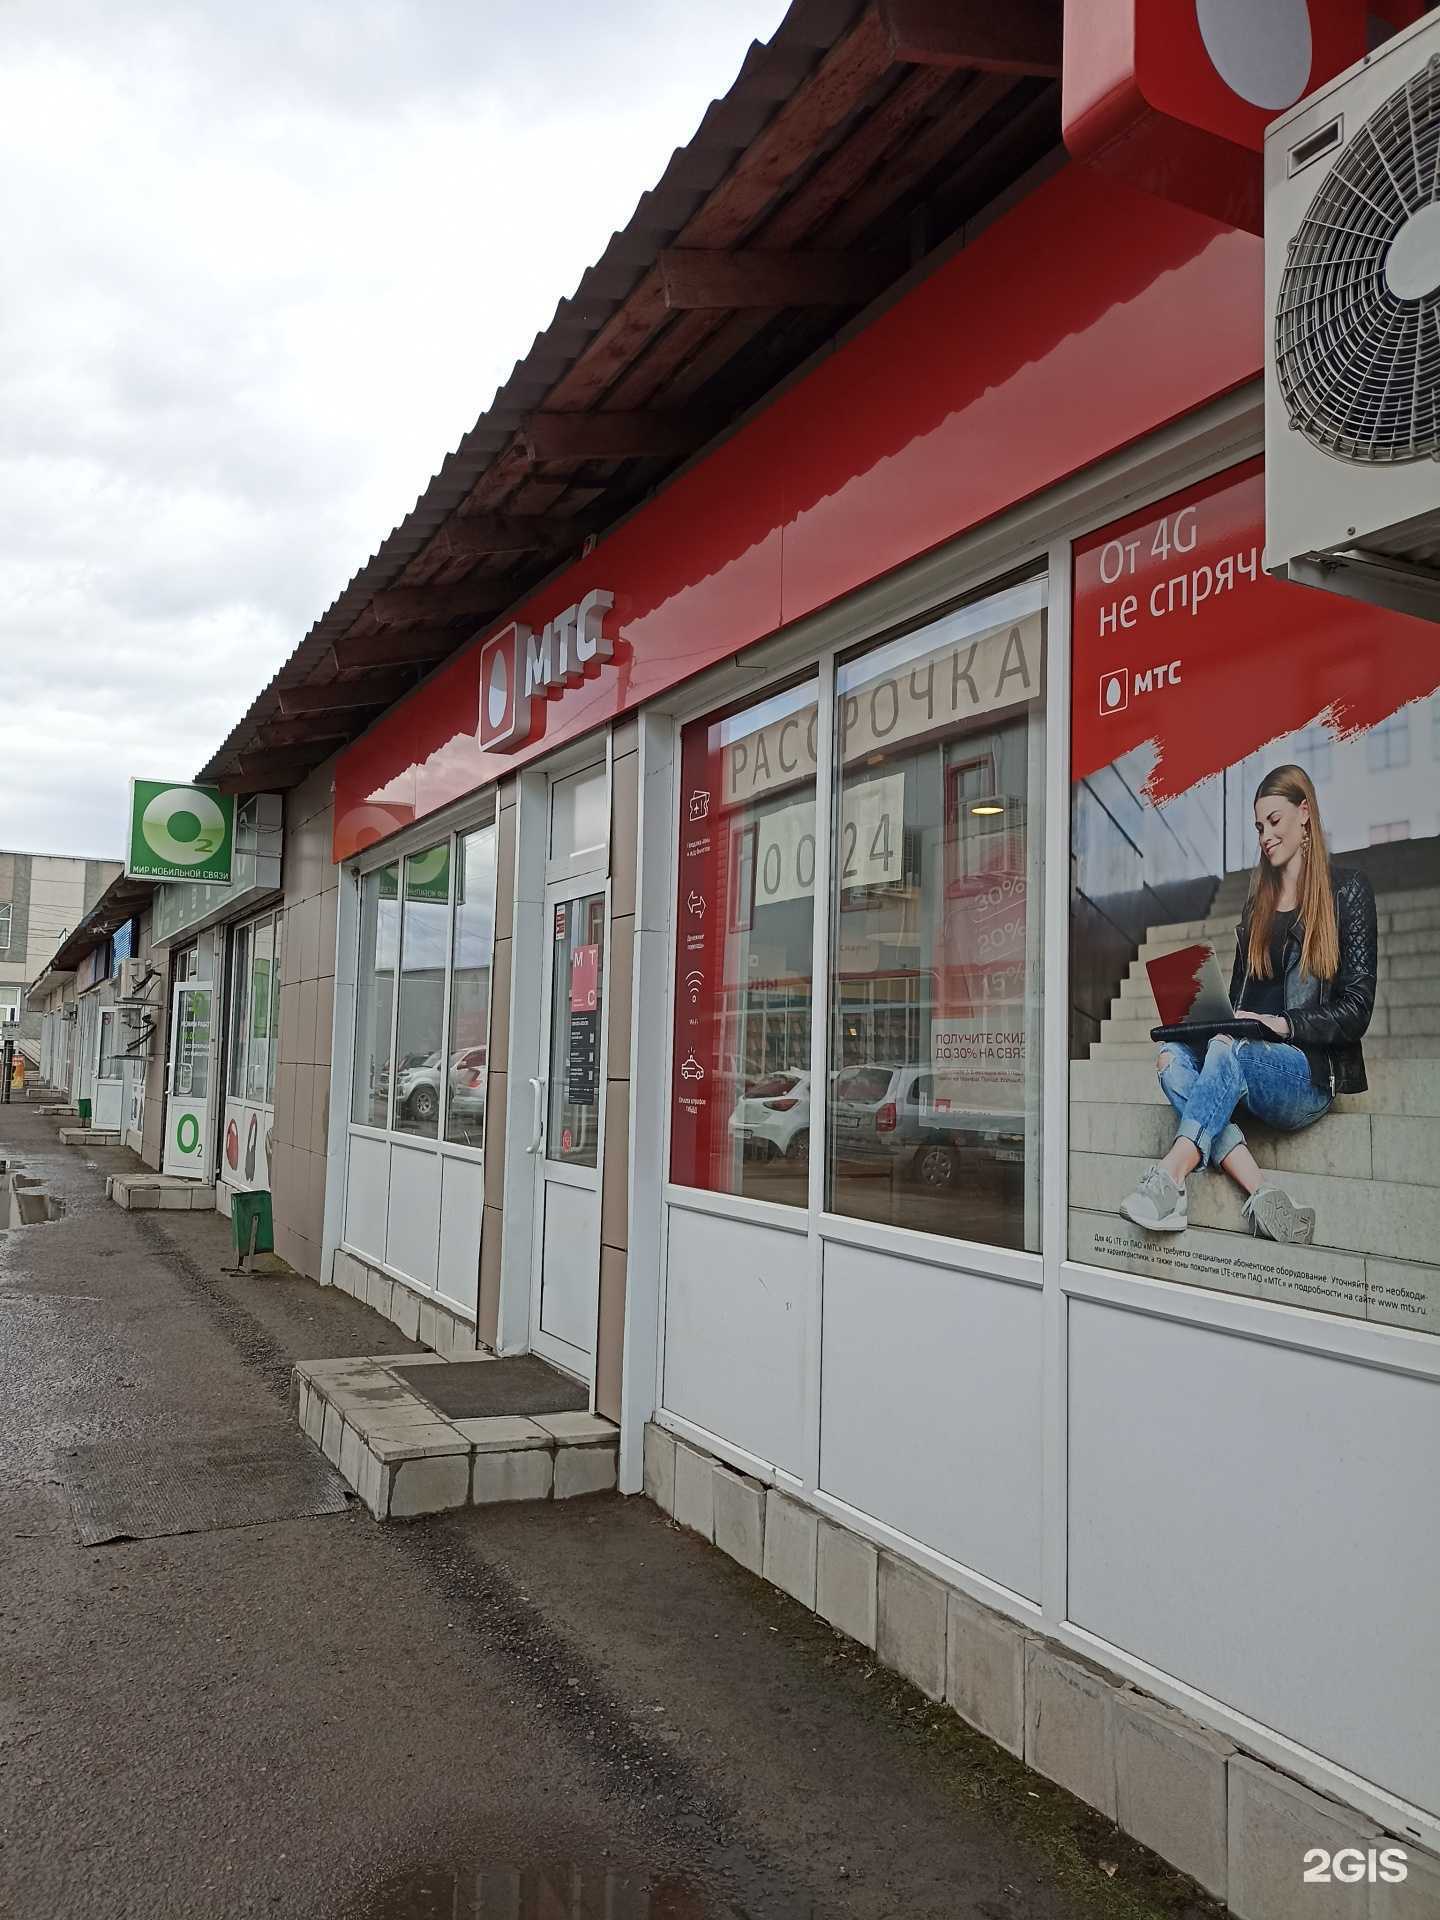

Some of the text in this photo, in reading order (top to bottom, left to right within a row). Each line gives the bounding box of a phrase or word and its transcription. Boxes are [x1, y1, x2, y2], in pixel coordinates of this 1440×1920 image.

[1100, 506, 1197, 584] От 4G
[1099, 595, 1138, 637] не
[525, 589, 613, 698] МТС
[1134, 660, 1182, 696] МТС
[132, 865, 229, 880] МИР МОБИЛЬНОЙ СВЯЗИ
[935, 1033, 993, 1045] ПОЛУЧИТЕ
[935, 1048, 952, 1060] ДО
[953, 1047, 978, 1059] 30%
[979, 1047, 995, 1059] НА
[1233, 1258, 1275, 1273] абонентское
[1331, 1276, 1369, 1291] Уточняйте
[1371, 1285, 1384, 1294] его
[1248, 1270, 1263, 1284] ПАО
[1294, 1283, 1342, 1299] подробности
[1344, 1291, 1353, 1301] на
[1354, 1293, 1376, 1306] сайте
